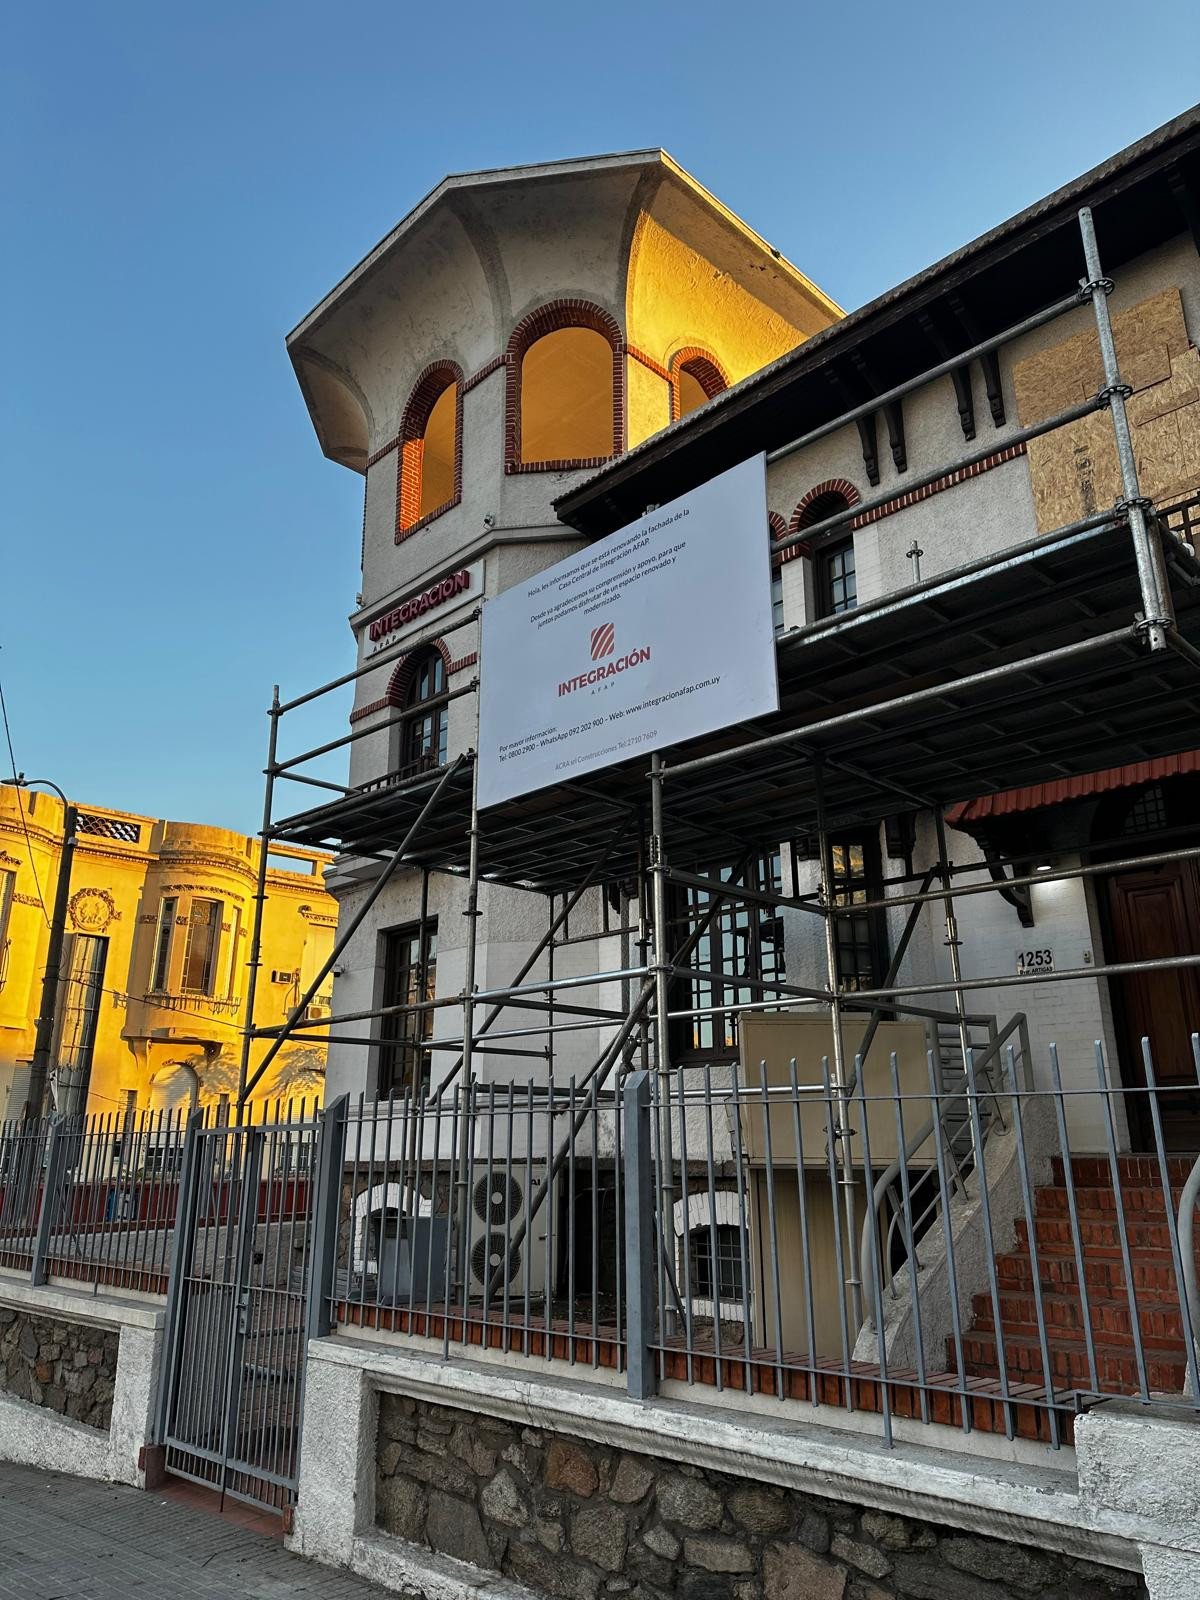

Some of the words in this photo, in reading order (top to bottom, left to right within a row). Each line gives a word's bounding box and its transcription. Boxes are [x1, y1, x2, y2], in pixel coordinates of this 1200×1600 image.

[530, 611, 546, 623] Desde
[554, 590, 588, 612] agradecemos
[658, 548, 673, 560] para
[673, 542, 686, 552] que
[541, 583, 549, 591] les
[549, 567, 580, 586] informamos
[580, 561, 591, 570] que
[610, 533, 641, 554] renovando
[648, 517, 673, 534] fachada
[674, 513, 683, 521] de
[558, 581, 571, 591] Casa
[571, 568, 592, 584] Central
[592, 565, 599, 573] de
[369, 569, 470, 641] INTEGRACIÓN
[538, 617, 554, 630] juntos
[554, 604, 578, 621] podamos
[578, 592, 602, 608] disfrutar
[602, 588, 610, 596] de
[610, 584, 618, 592] un
[619, 573, 641, 588] espacio
[641, 559, 672, 577] renovado
[558, 646, 651, 697] INTEGRACIÓN
[499, 745, 508, 753] Por
[508, 739, 524, 749] mayor
[508, 748, 522, 759] 0800
[522, 743, 535, 754] 2900
[540, 732, 568, 747] WhatsApp
[568, 726, 580, 736] 092
[580, 722, 591, 732] 202
[592, 717, 604, 728] 900
[625, 676, 720, 715] www.integracionafap.com.uy
[577, 745, 618, 763] Construcciones
[1018, 949, 1053, 968] 1253
